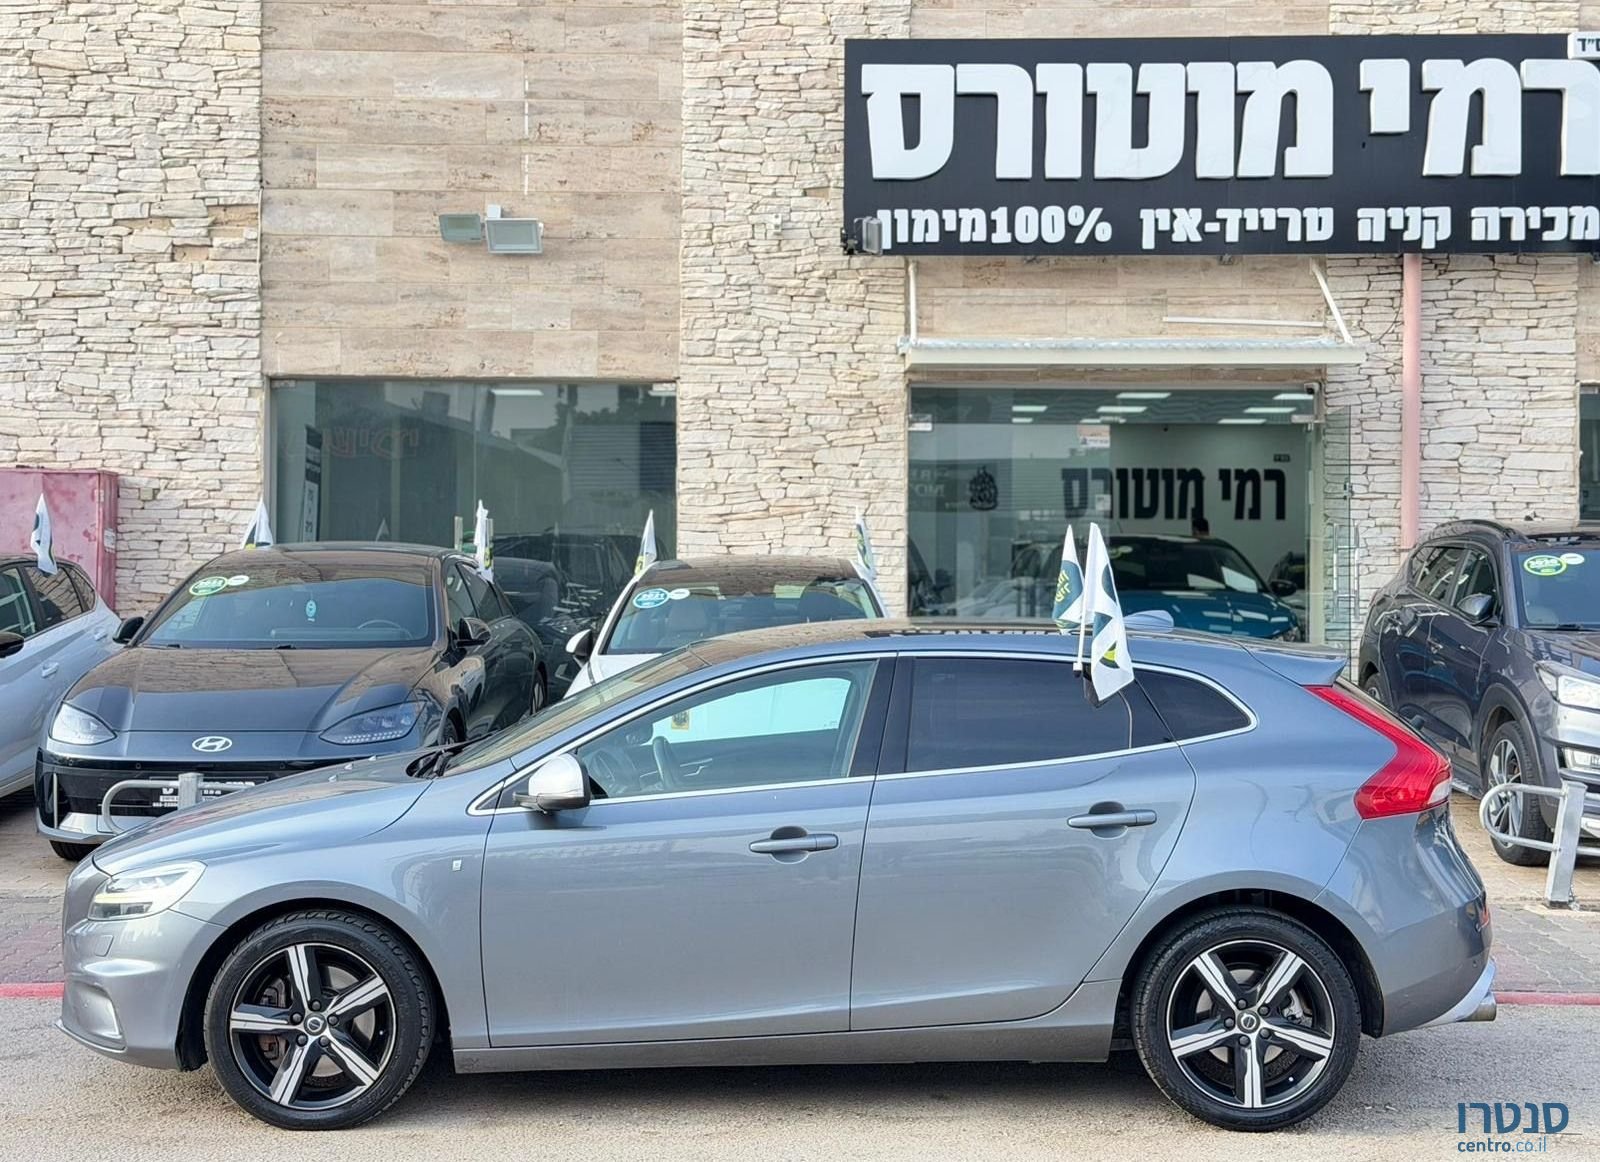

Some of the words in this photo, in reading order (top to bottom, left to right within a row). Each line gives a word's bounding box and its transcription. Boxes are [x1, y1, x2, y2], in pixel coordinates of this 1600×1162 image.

[861, 60, 1334, 180] מוטורס
[1360, 59, 1600, 176] רמי
[1139, 207, 1334, 250] טרייד-אין
[1357, 206, 1452, 249] קניה
[1470, 206, 1600, 241] מכירה
[1061, 467, 1206, 520] מוטורס
[1218, 468, 1287, 520] רמי
